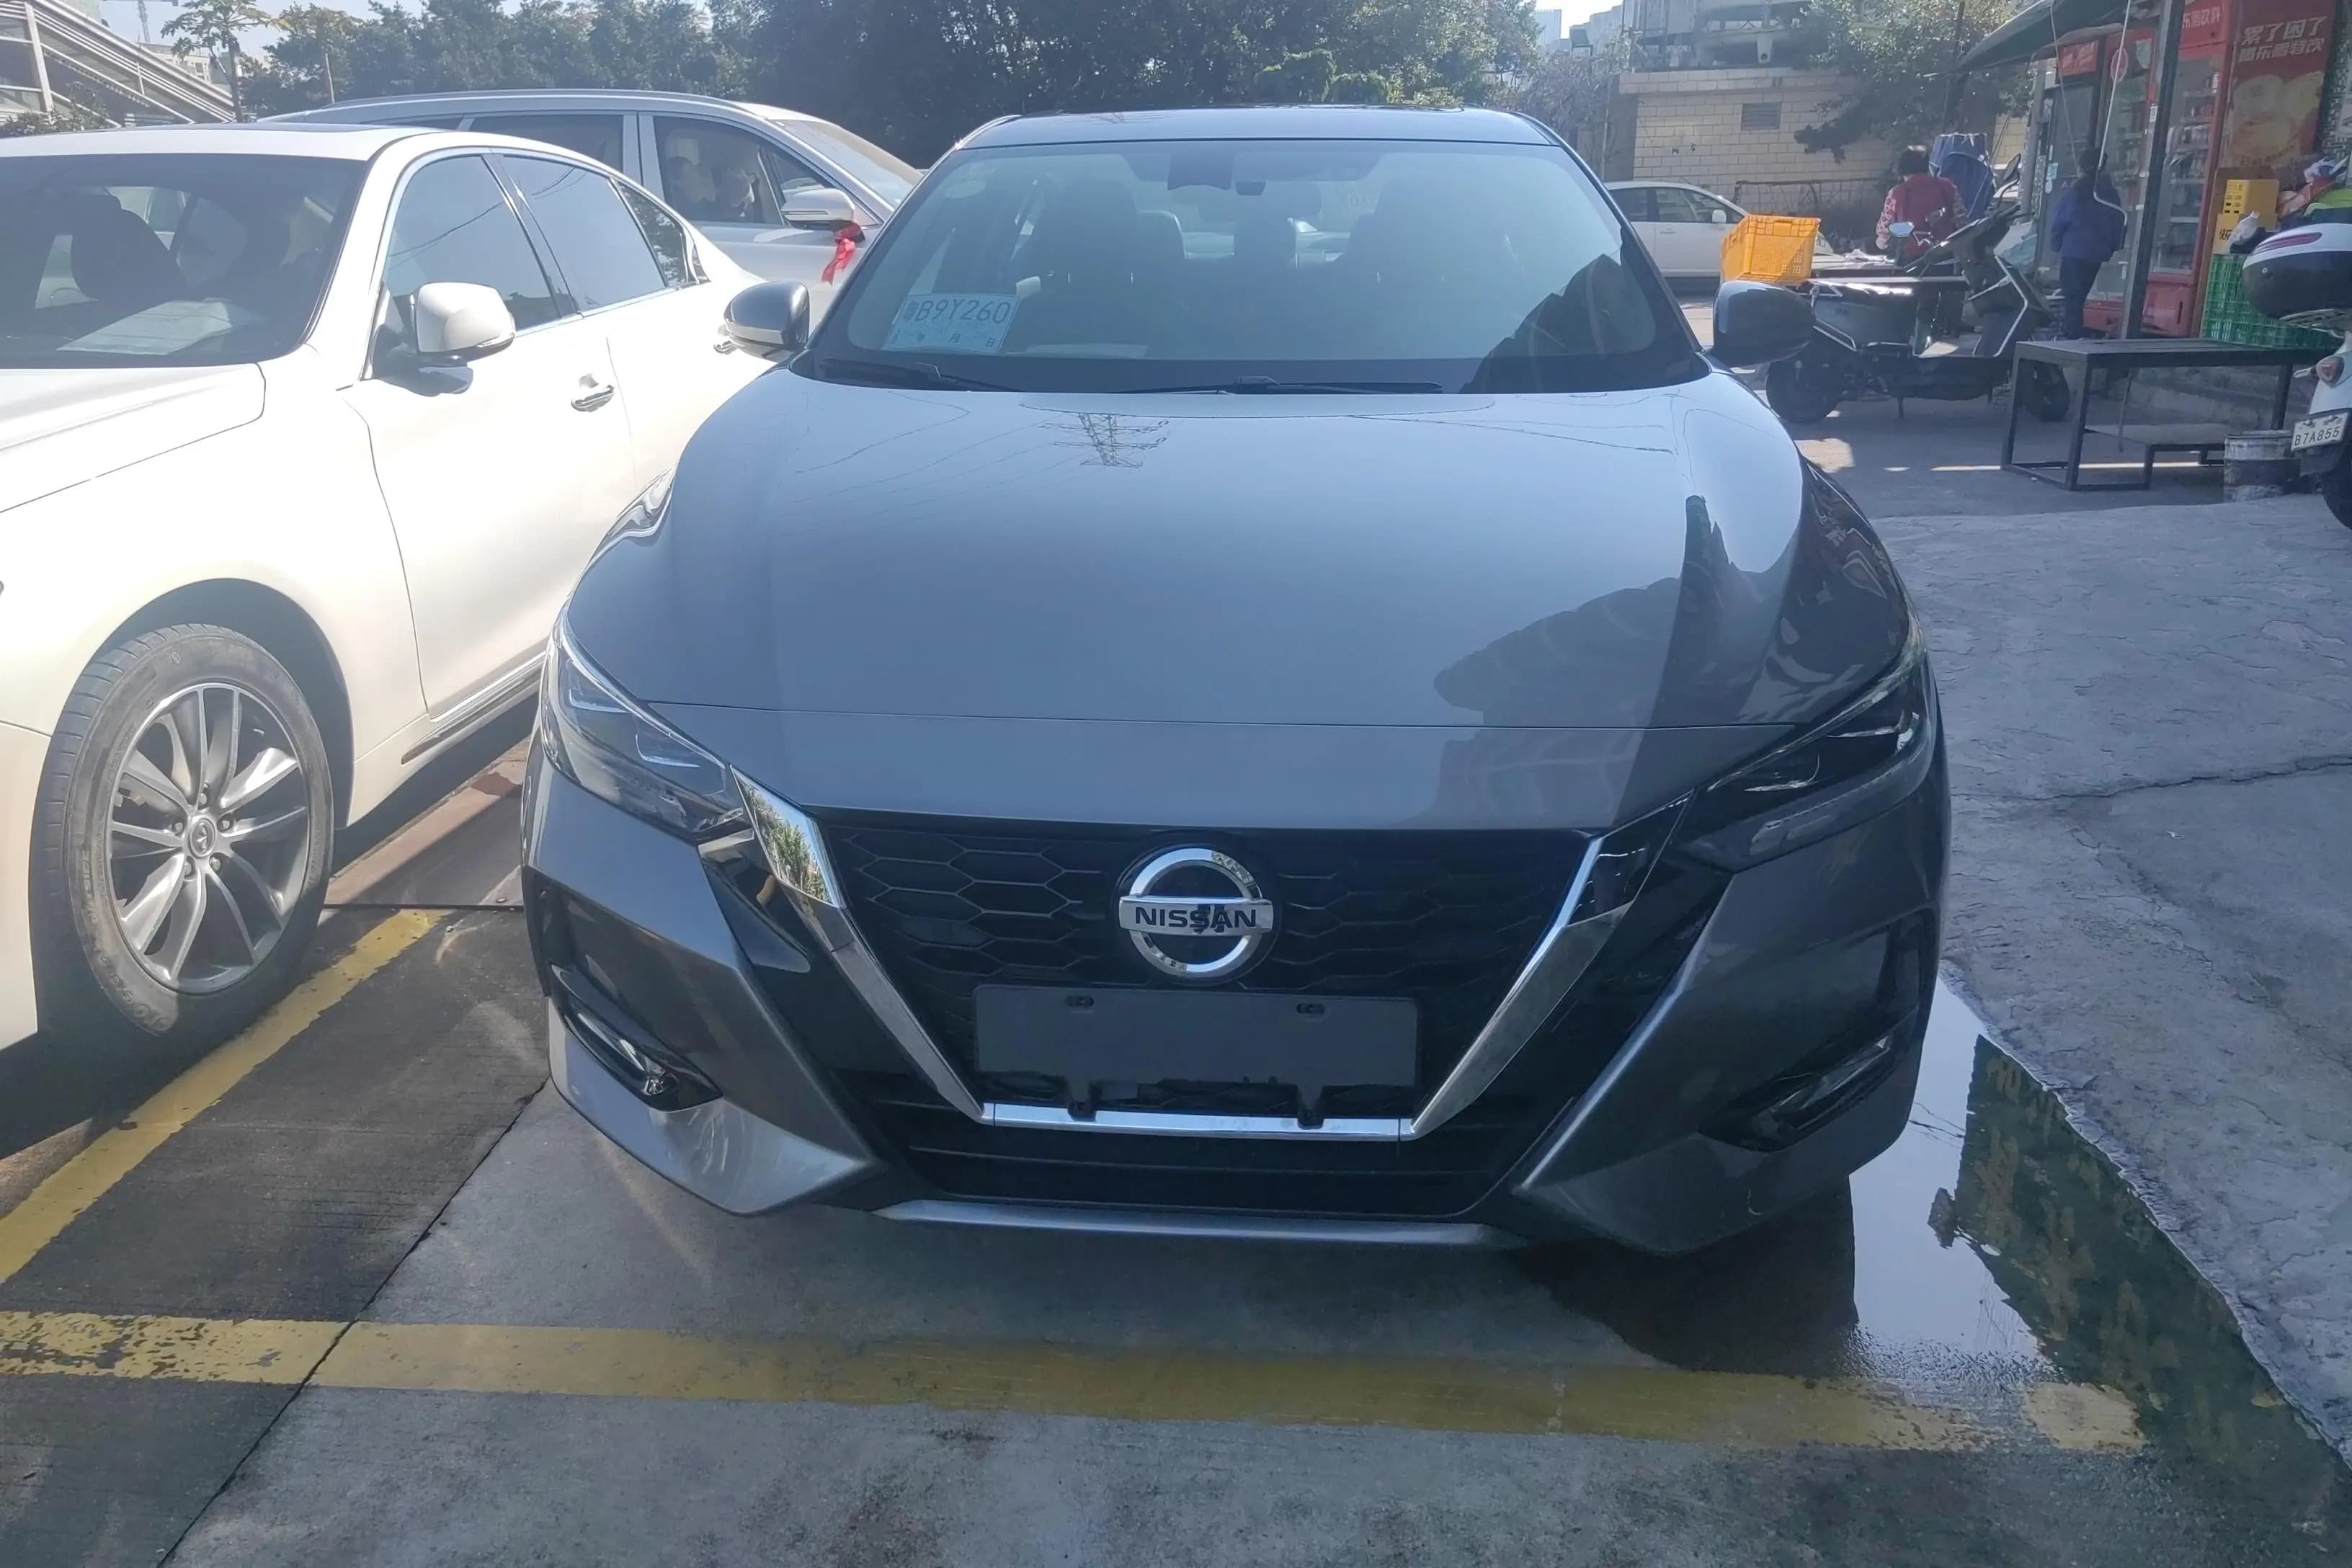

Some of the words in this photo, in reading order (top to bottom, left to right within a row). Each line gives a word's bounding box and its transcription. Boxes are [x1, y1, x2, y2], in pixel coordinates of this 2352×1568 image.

[2242, 16, 2328, 45] 累了困了
[986, 337, 996, 347] 日
[2294, 426, 2341, 446] B7A855
[1135, 906, 1256, 928] NISSAN
